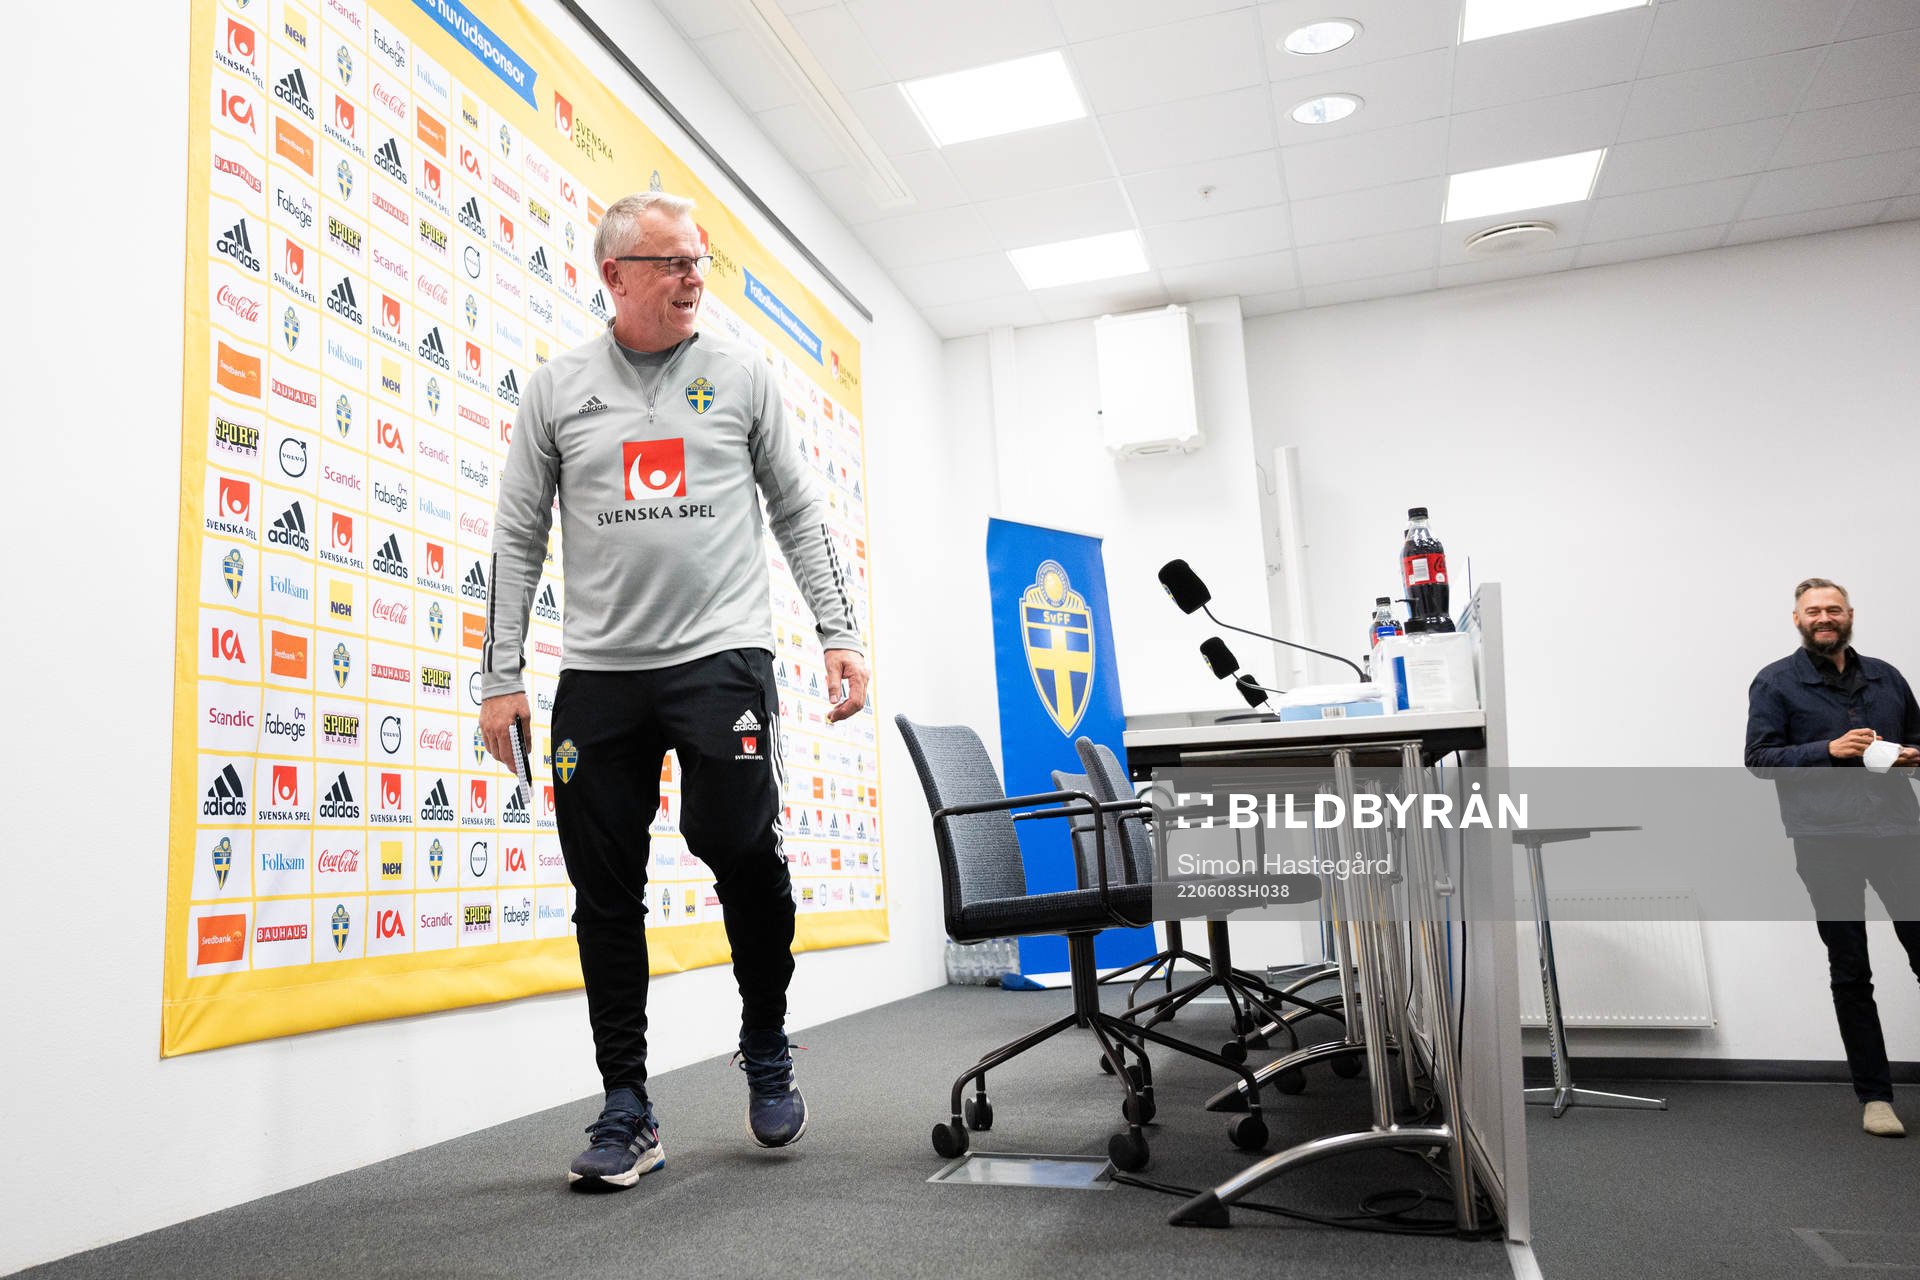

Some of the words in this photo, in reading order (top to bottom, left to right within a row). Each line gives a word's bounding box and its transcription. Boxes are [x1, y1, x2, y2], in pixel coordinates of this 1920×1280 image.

[374, 29, 405, 68] Fabege
[216, 50, 250, 76] SVENSKA
[251, 70, 264, 90] SPEL
[221, 89, 256, 135] ICA
[274, 83, 315, 120] adidas
[324, 124, 351, 151] SVENSKA
[352, 143, 366, 159] SPEL
[575, 118, 614, 162] SVENSKA
[576, 135, 596, 163] SPEL
[215, 154, 261, 193] BAUHAUS
[374, 151, 407, 185] adidas
[460, 145, 482, 180] ICA
[560, 176, 577, 208] ICA
[277, 189, 312, 229] Fabege
[372, 193, 409, 225] BAUHAUS
[328, 216, 361, 250] SPORT
[419, 218, 447, 250] SPORT
[458, 211, 486, 239] adidas
[217, 239, 260, 273] adidas
[373, 249, 409, 280] Scandic
[528, 262, 552, 284] adidas
[274, 273, 300, 295] SVENSKA
[300, 289, 316, 303] SPEL
[327, 294, 363, 325] adidas
[372, 326, 397, 345] SVENSKA
[398, 338, 411, 352] SPEL
[327, 339, 363, 370] Folksam
[418, 349, 450, 370] adidas
[457, 371, 479, 389] SVENSKA
[272, 378, 317, 408] BAUHAUS
[497, 386, 520, 407] adida
[458, 405, 490, 429] BAUHAUS
[579, 403, 608, 414] adidas
[216, 417, 259, 450] SPORT
[377, 419, 404, 454] ICA
[500, 420, 512, 445] IC
[216, 439, 257, 457] BLADET
[282, 453, 304, 463] VOLVO
[418, 441, 450, 465] Scandic
[324, 466, 361, 490] Scandic
[460, 460, 489, 487] Fabege
[374, 482, 408, 512] Fabege
[598, 507, 673, 526] SVENSKA
[679, 505, 716, 518] SPEL
[206, 519, 244, 535] SVENSKA
[246, 528, 257, 541] SPEL
[268, 528, 309, 552] adidas
[320, 550, 349, 565] SVENSKA
[350, 558, 364, 570] SPEL
[372, 558, 408, 579] adidas
[270, 576, 309, 600] Folksam
[417, 577, 441, 590] SVENSKA
[442, 584, 454, 594] SPEL
[462, 583, 486, 600] adida
[536, 606, 561, 622] adidas
[1043, 611, 1070, 624] SvFF
[212, 627, 246, 664] ICA
[371, 664, 410, 683] BAUHAUS
[421, 667, 451, 690] SPORT
[537, 694, 553, 712] Fabe
[209, 708, 254, 727] Scandic
[265, 713, 305, 742] Fabege
[323, 713, 359, 738] SPORT
[733, 723, 761, 731] adidas
[326, 736, 358, 744] BLADET
[203, 797, 246, 816] adidas
[259, 811, 293, 821] SVENSKA
[295, 812, 310, 821] SPEL
[320, 802, 359, 819] adidas
[371, 814, 398, 823] SVENSKA
[399, 815, 413, 823] SPEL
[421, 807, 454, 822] adidas
[503, 810, 530, 824] adidas
[462, 817, 483, 825] SVENSKA
[262, 854, 305, 872] Folksam
[506, 848, 526, 872] ICA
[376, 909, 405, 939] ICA
[421, 912, 453, 929] Scandic
[464, 905, 491, 925] SPORT
[504, 906, 530, 926] Fabege
[201, 935, 231, 945] Swedbank
[257, 925, 307, 943] BAUHAUS
